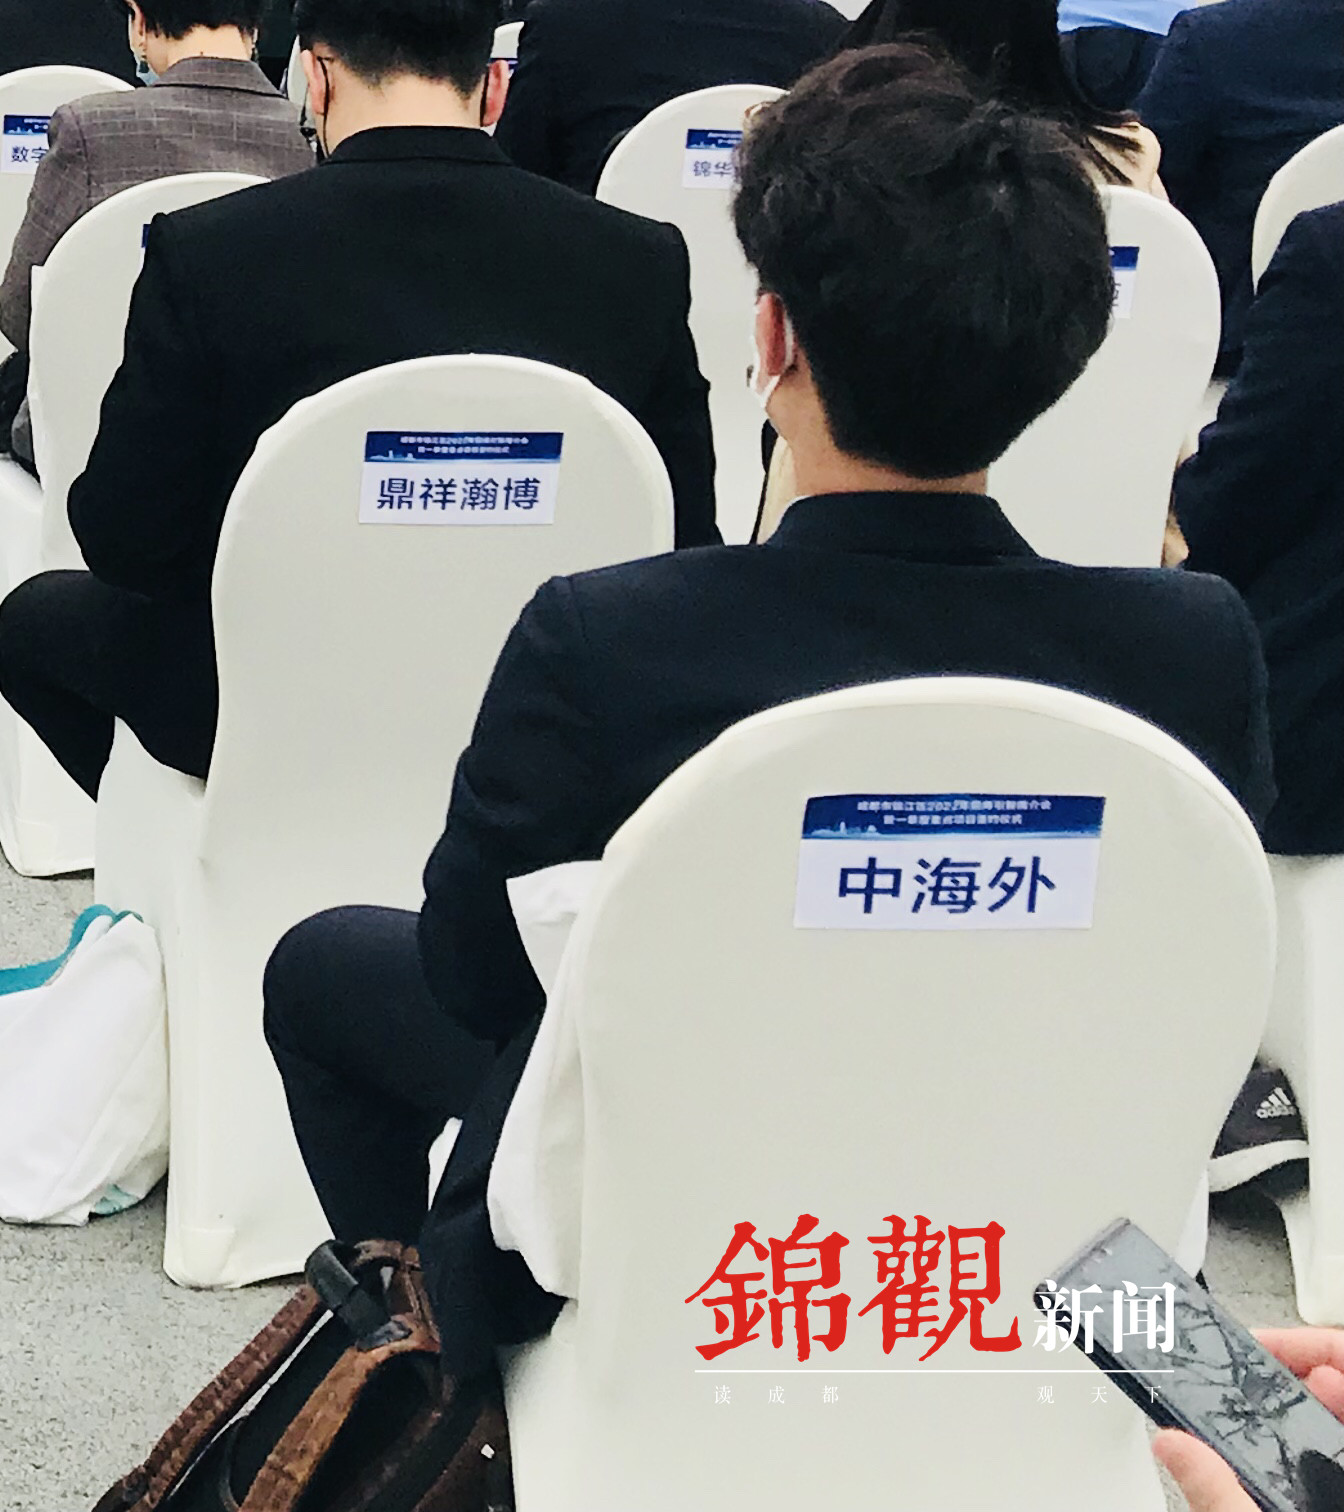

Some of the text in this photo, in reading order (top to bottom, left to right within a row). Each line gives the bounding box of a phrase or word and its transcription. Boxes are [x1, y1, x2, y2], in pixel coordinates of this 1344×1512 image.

[377, 477, 541, 511] 鼎祥瀚博
[838, 856, 1057, 914] 中海外
